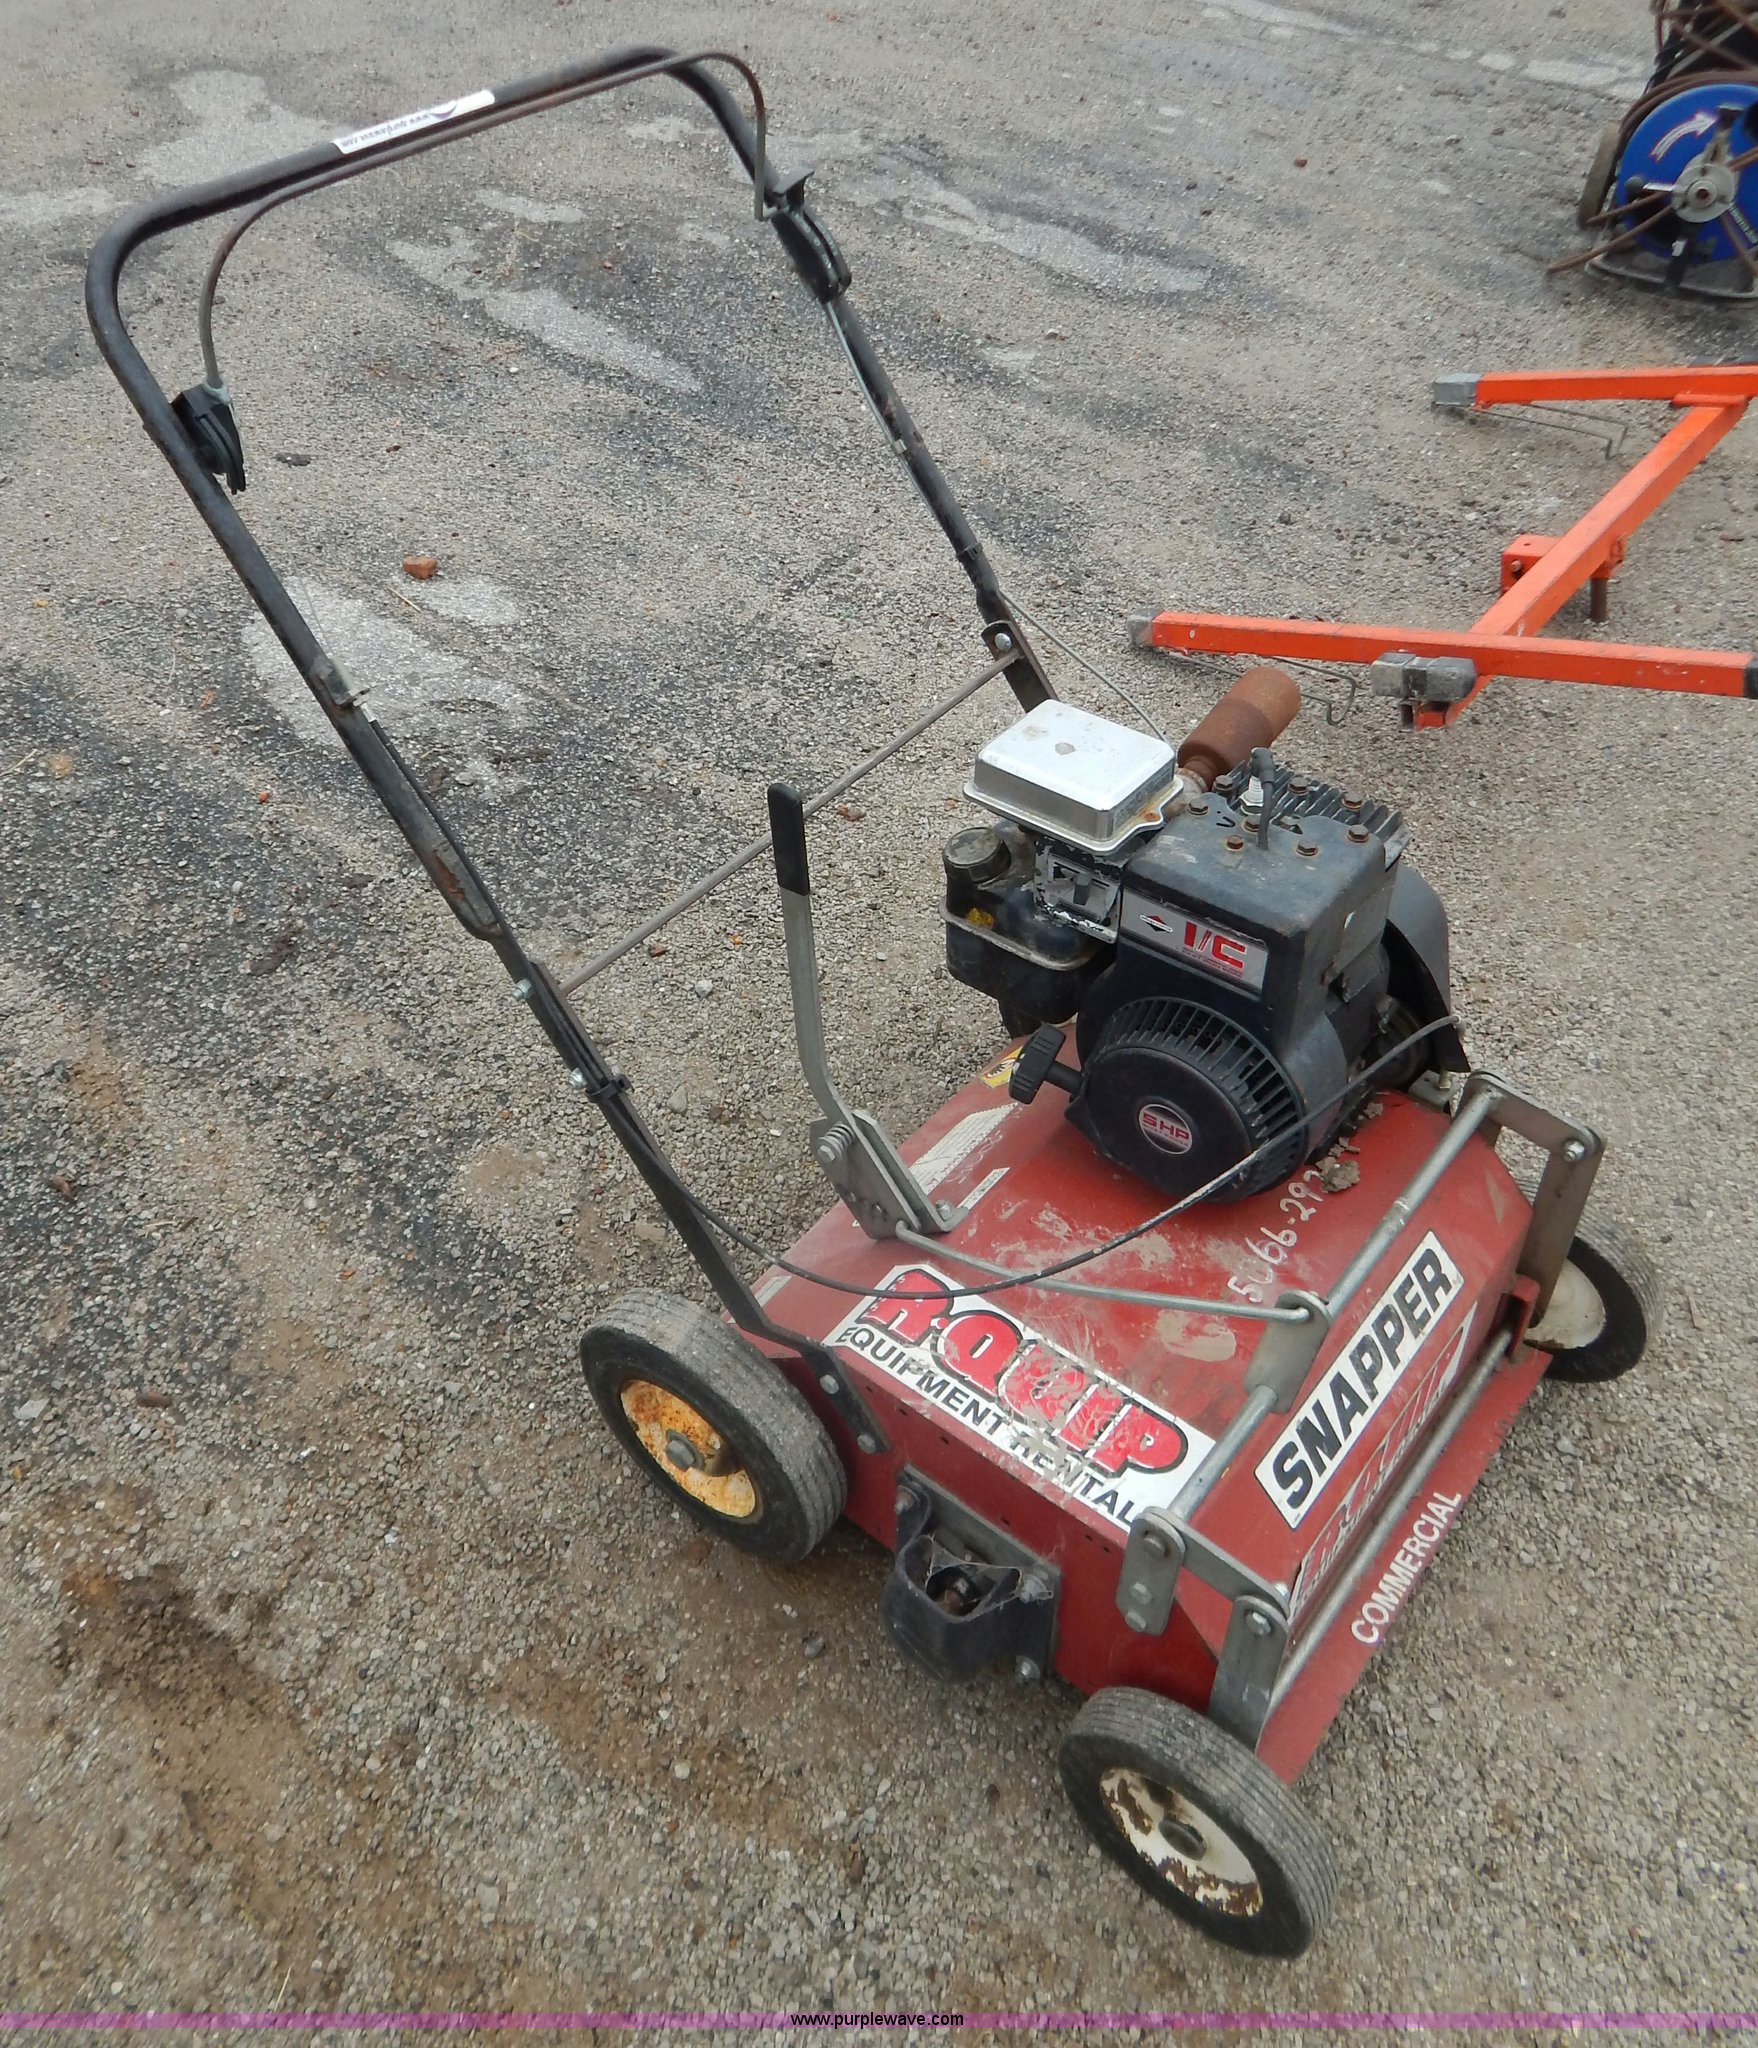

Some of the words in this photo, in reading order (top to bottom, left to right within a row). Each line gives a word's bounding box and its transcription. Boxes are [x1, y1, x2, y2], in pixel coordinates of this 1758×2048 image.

[835, 1326, 1012, 1438] EQUIPMENT
[1273, 1247, 1453, 1510] SNAPPER
[1351, 1490, 1462, 1645] COMMERCIAL
